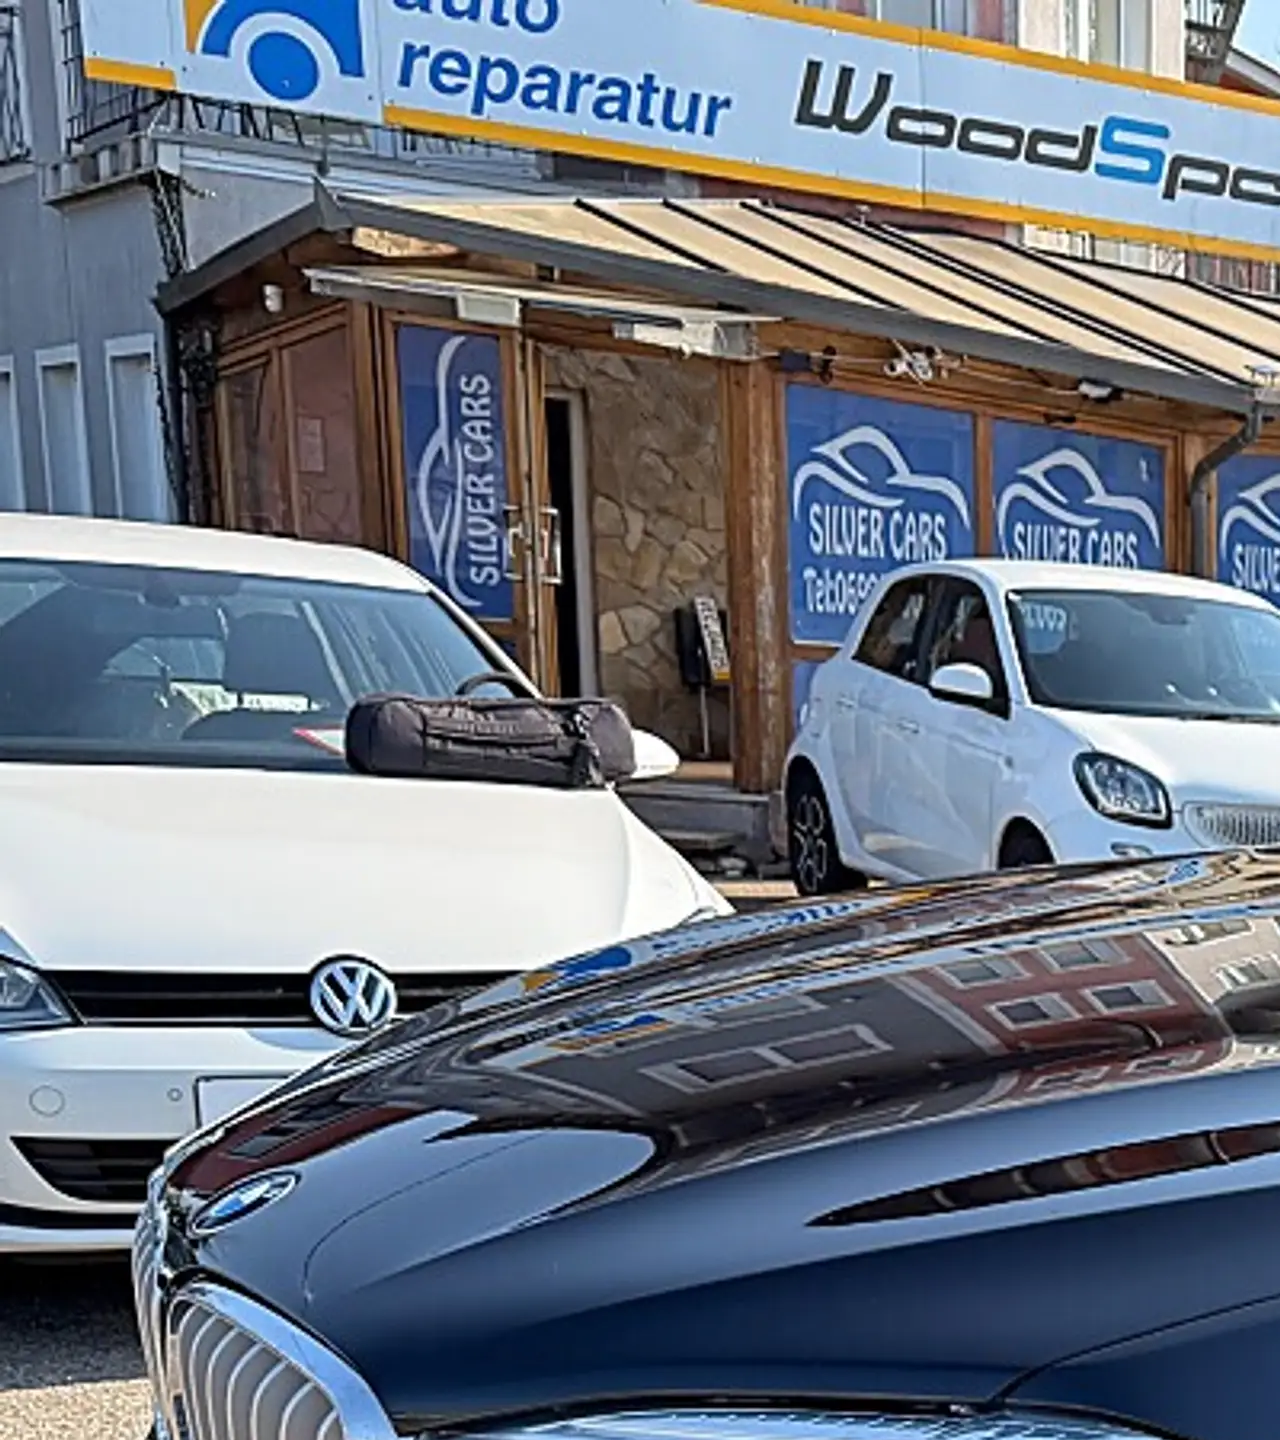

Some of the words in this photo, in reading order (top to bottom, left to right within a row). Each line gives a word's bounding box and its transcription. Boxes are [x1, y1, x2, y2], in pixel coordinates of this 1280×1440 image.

[394, 0, 559, 33] uto
[398, 41, 732, 137] reparatur
[461, 374, 491, 459] CARS
[464, 477, 498, 586] SILVER
[808, 503, 885, 559] SILVER
[889, 511, 947, 561] CARS
[1012, 521, 1079, 564] SILVER
[1087, 527, 1138, 570] CARS
